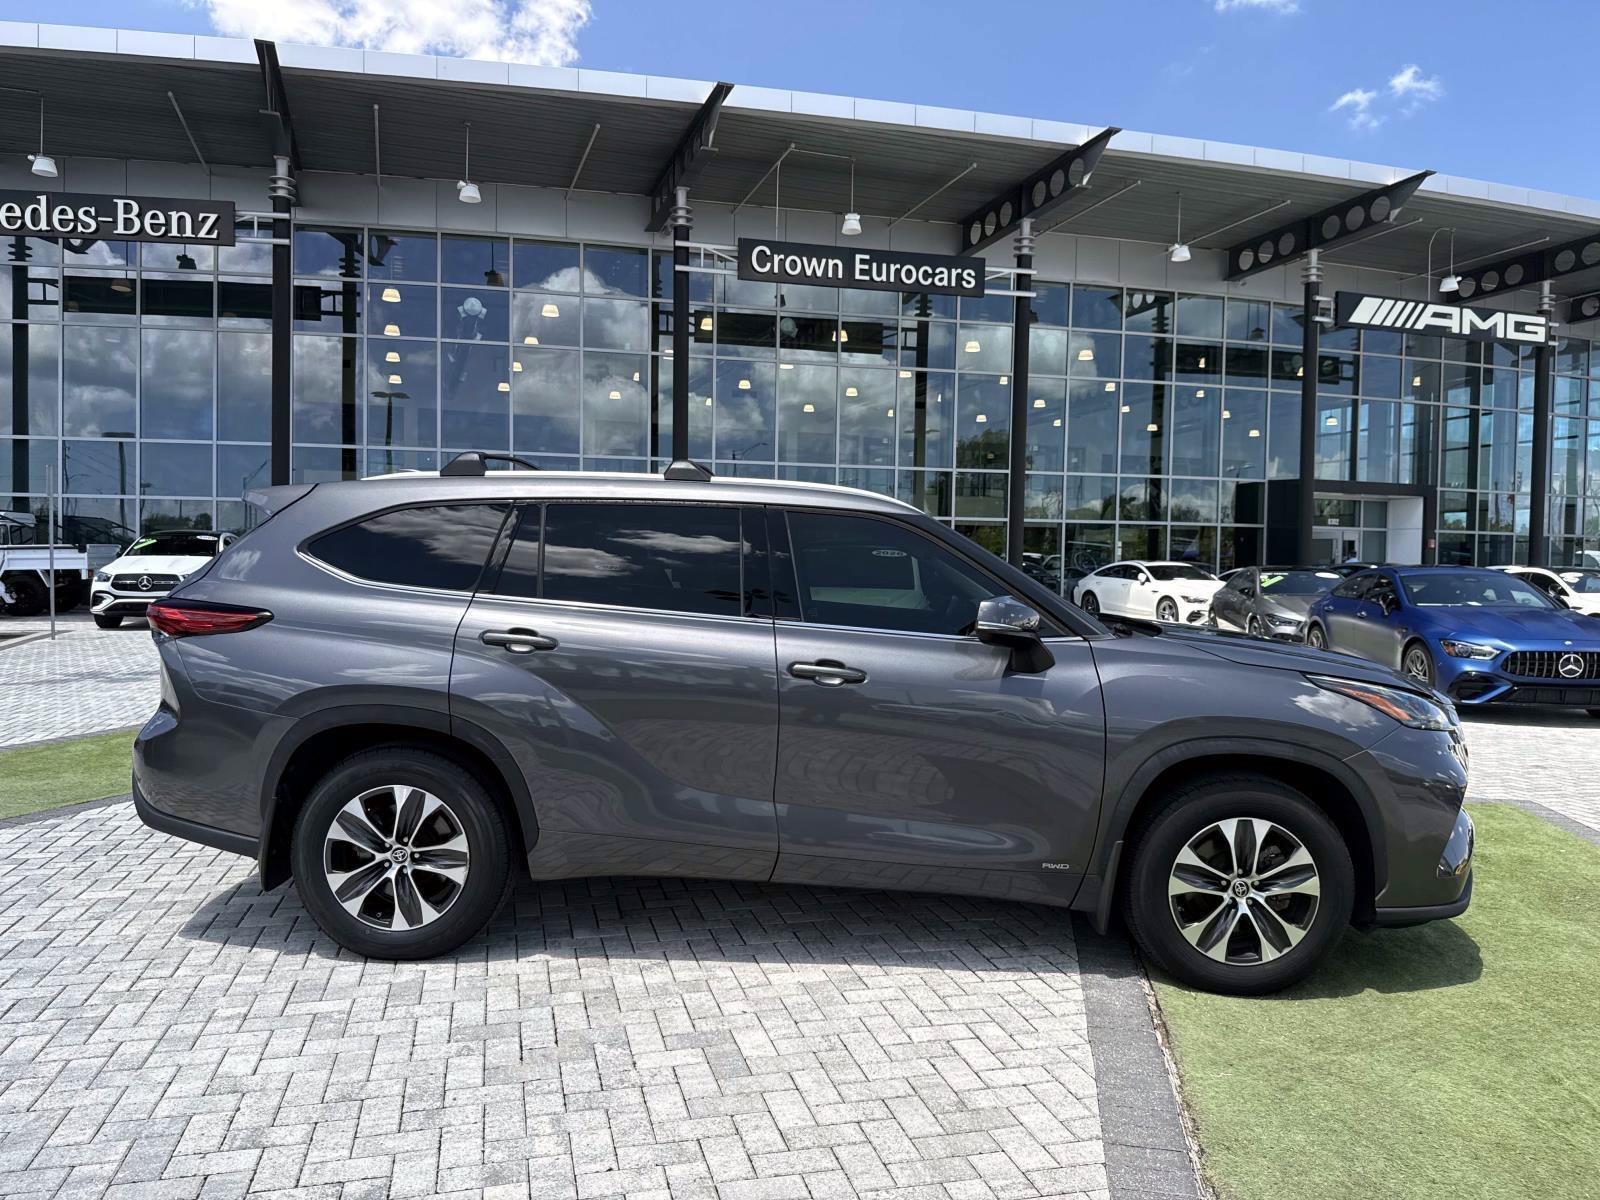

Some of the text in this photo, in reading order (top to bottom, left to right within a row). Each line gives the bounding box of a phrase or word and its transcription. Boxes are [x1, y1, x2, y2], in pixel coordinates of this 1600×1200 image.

[751, 245, 977, 289] Crown Eurocars
[1413, 303, 1546, 343] AMG
[1041, 862, 1070, 870] AWD
